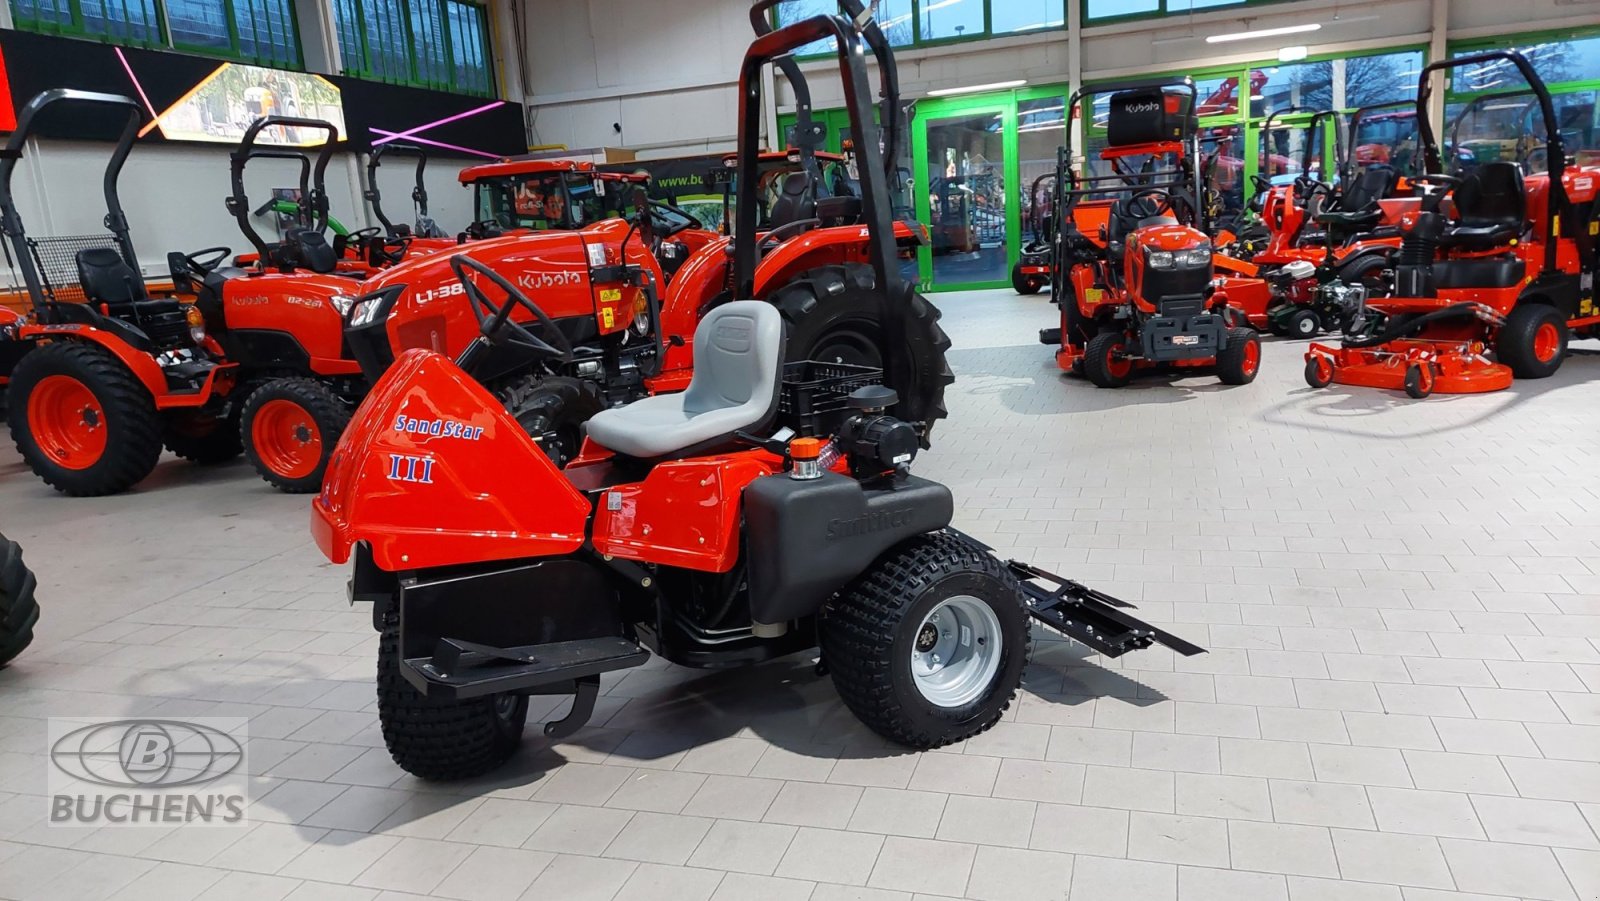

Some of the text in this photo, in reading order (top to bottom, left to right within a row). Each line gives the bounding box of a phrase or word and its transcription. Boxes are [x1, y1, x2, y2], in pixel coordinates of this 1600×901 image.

[1125, 102, 1160, 113] Kubota
[658, 174, 704, 188] www.bu
[518, 270, 581, 289] Kubota
[415, 283, 467, 304] L1-38
[386, 454, 436, 484] III
